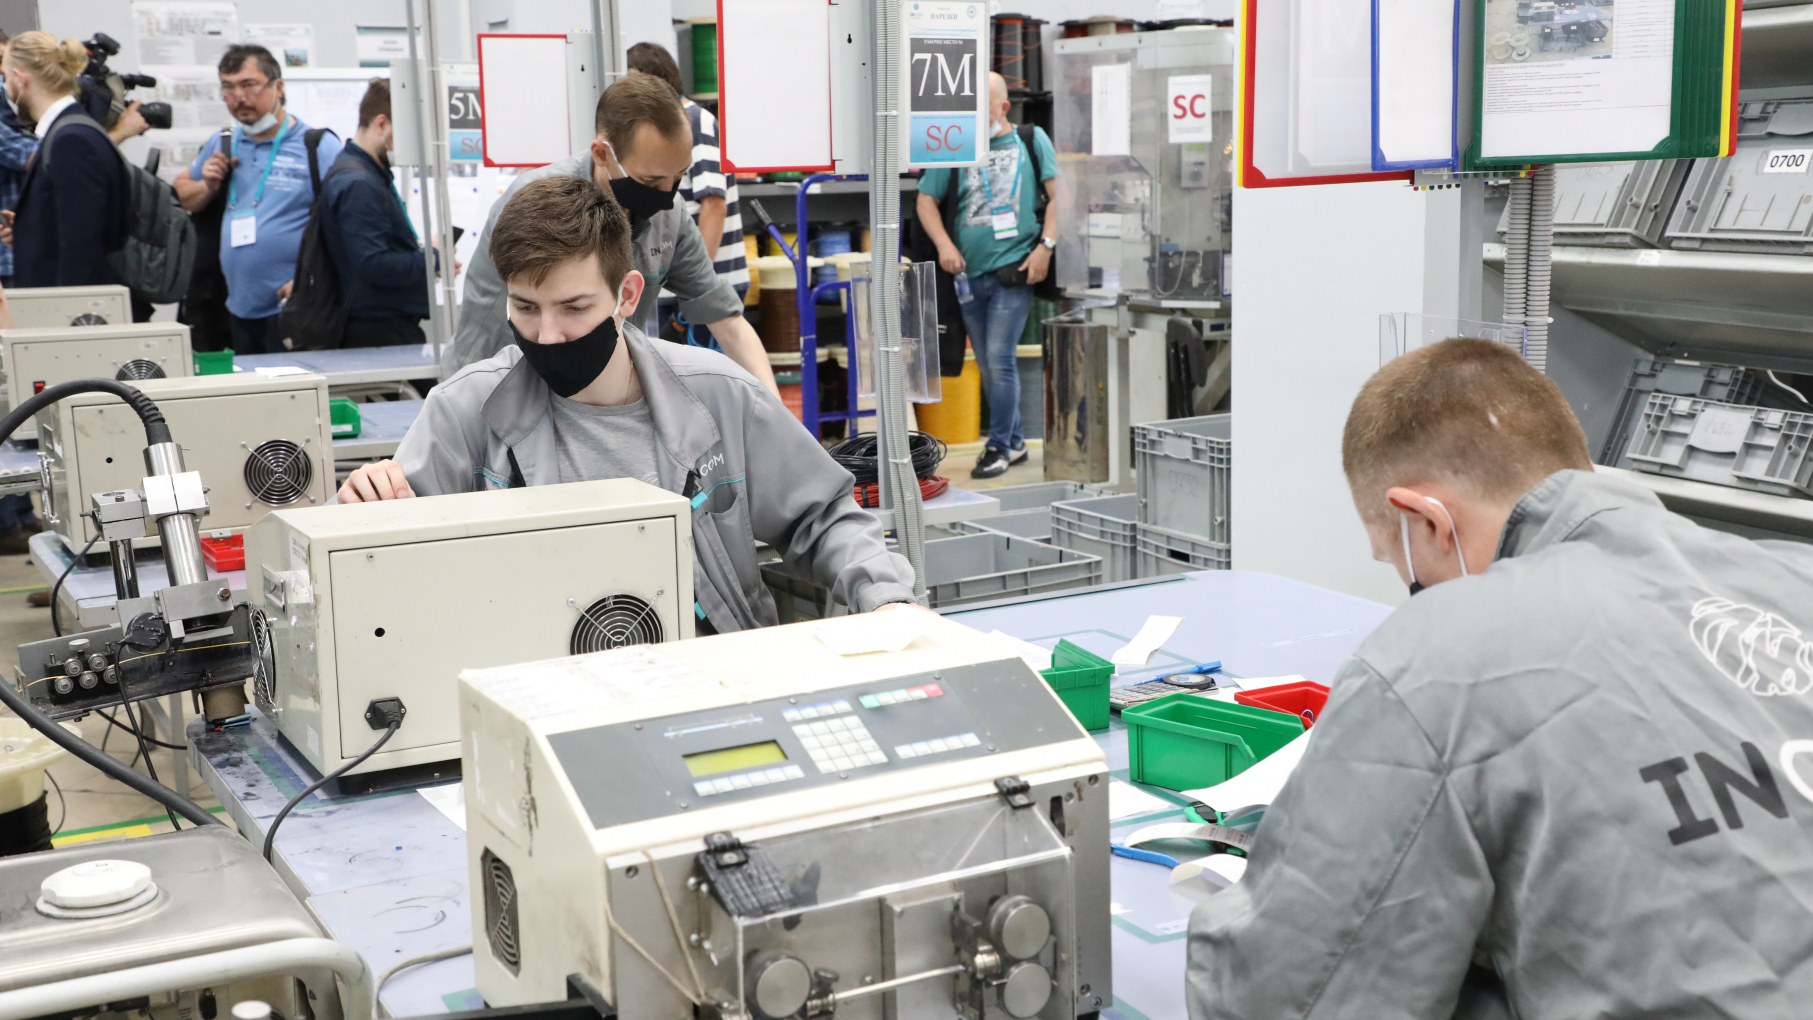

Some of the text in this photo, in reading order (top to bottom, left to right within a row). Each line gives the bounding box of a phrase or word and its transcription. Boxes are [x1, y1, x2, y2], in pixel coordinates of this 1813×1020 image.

[1173, 93, 1206, 119] SC
[925, 125, 963, 152] SC
[1769, 154, 1805, 168] 0700
